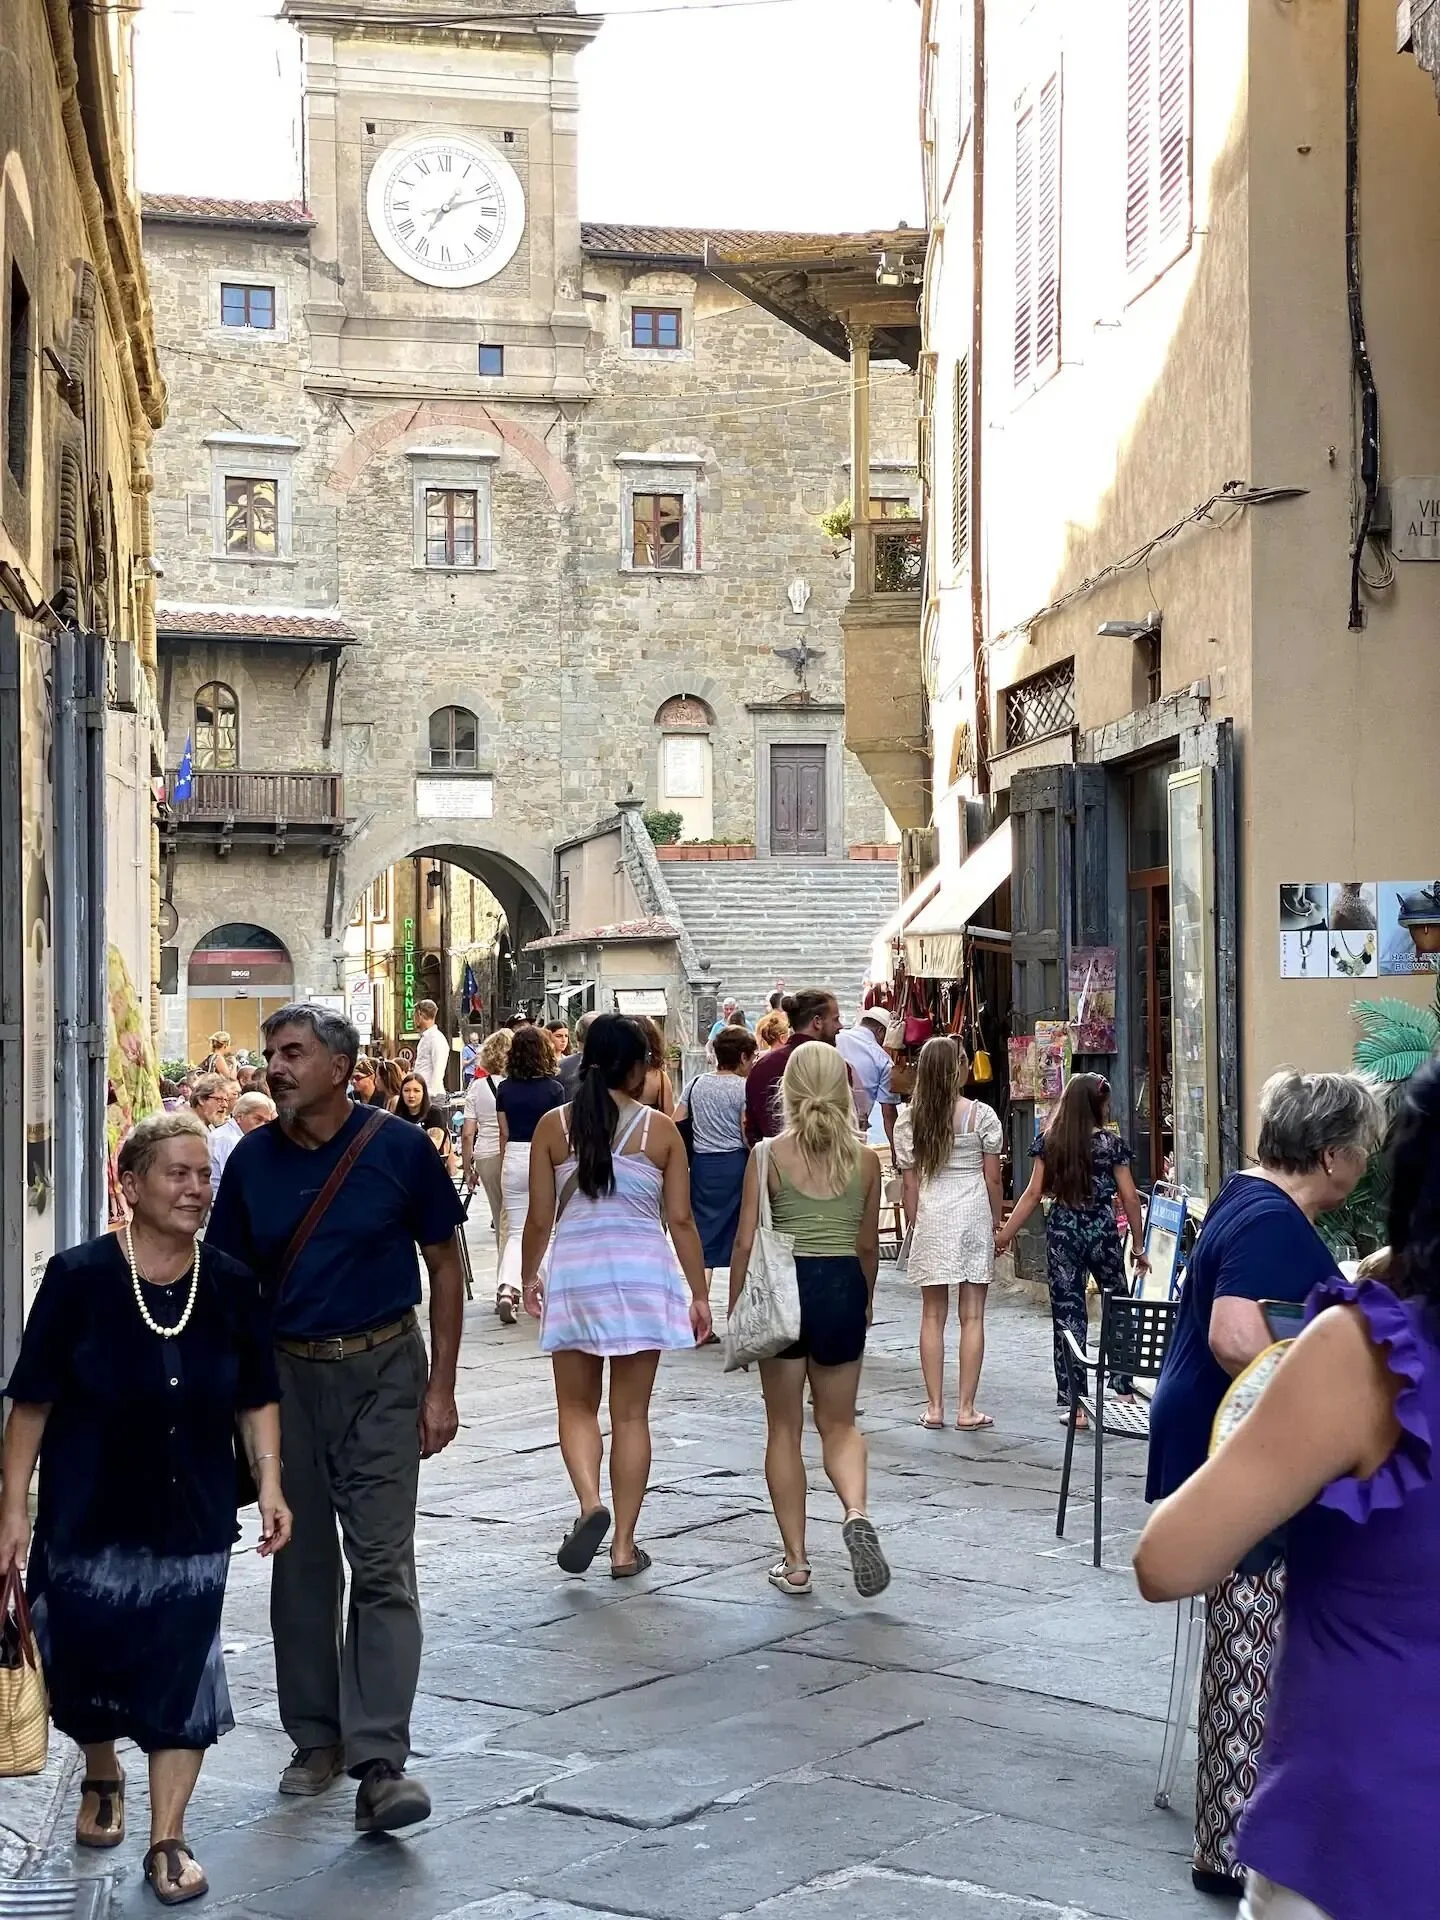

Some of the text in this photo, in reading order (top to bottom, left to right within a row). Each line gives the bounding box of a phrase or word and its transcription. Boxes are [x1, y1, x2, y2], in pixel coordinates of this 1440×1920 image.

[437, 155, 452, 172] XII
[1395, 962, 1429, 971] BLOWN
[404, 918, 414, 1031] RISTORANTE
[401, 1050, 410, 1060] 10
